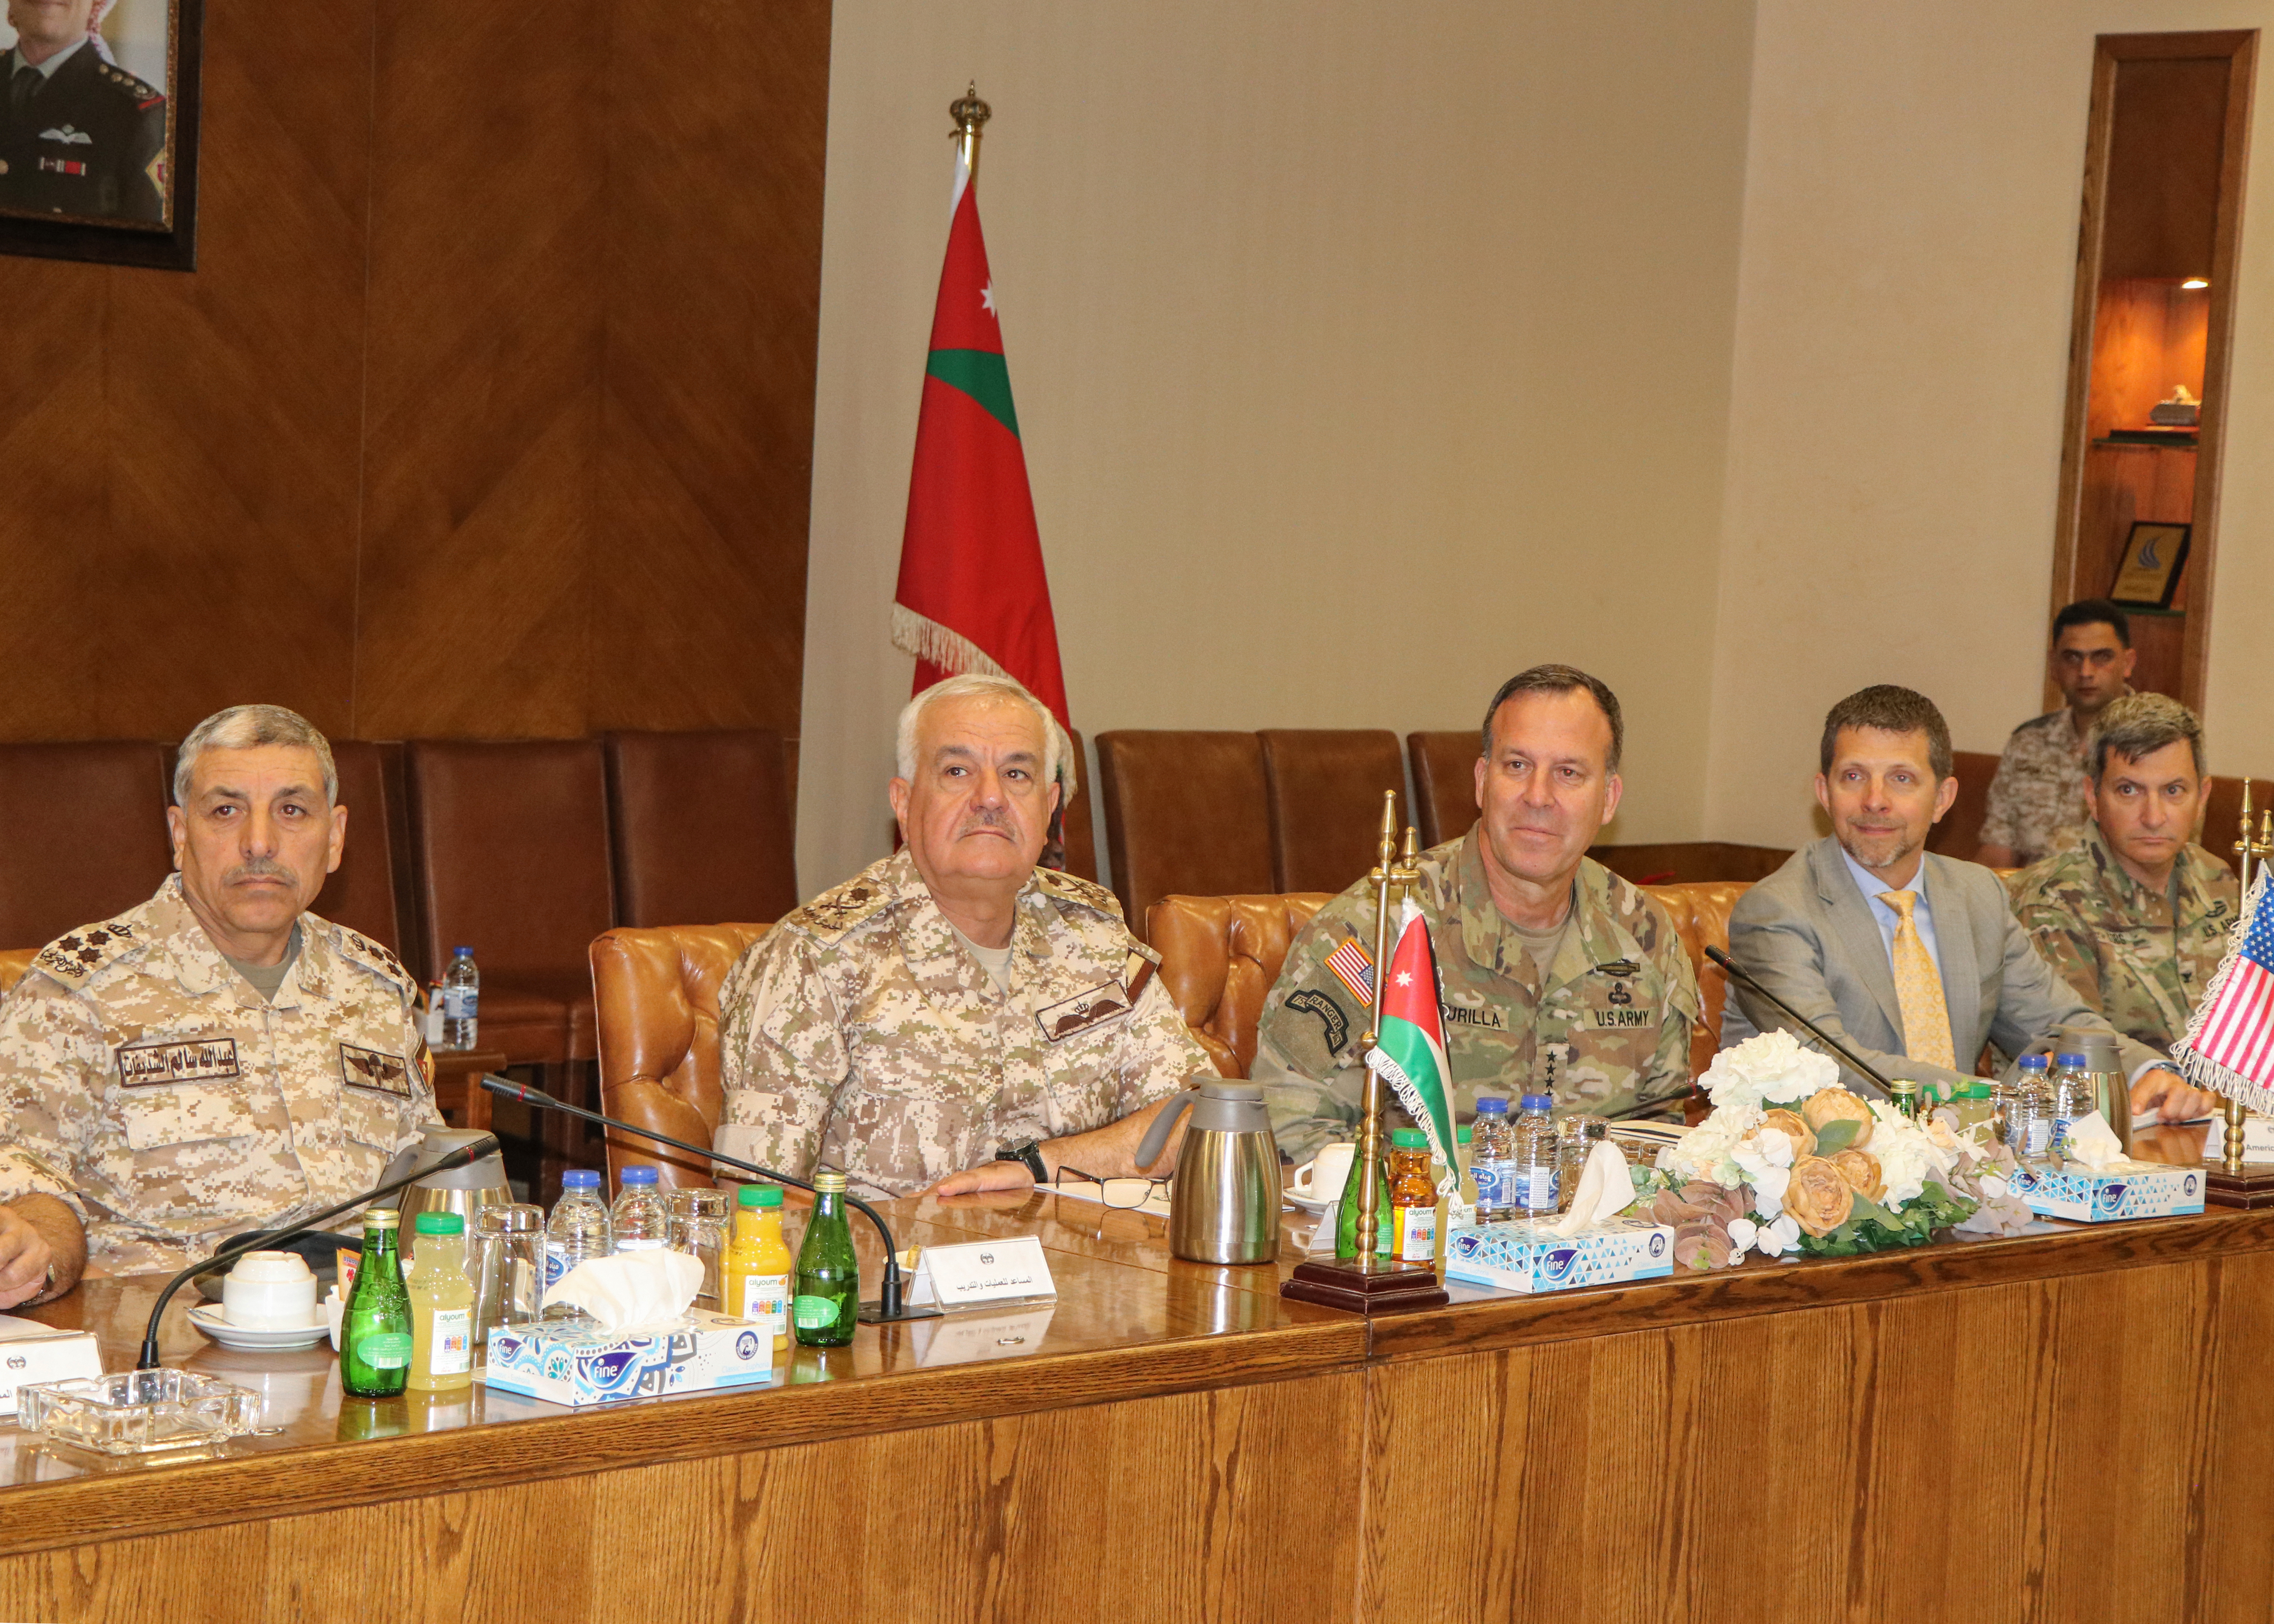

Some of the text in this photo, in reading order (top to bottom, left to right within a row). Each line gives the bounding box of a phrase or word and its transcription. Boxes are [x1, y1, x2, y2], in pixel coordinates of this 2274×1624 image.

[1309, 996, 1342, 1030] RANGER
[1447, 1006, 1501, 1028] URILLA
[1618, 1010, 1650, 1027] ARMY
[549, 1263, 559, 1271] مياه
[749, 1279, 778, 1287] alyoum
[956, 1275, 1033, 1292] المساعد للعمليات والتدريب
[439, 1313, 465, 1322] alyoum
